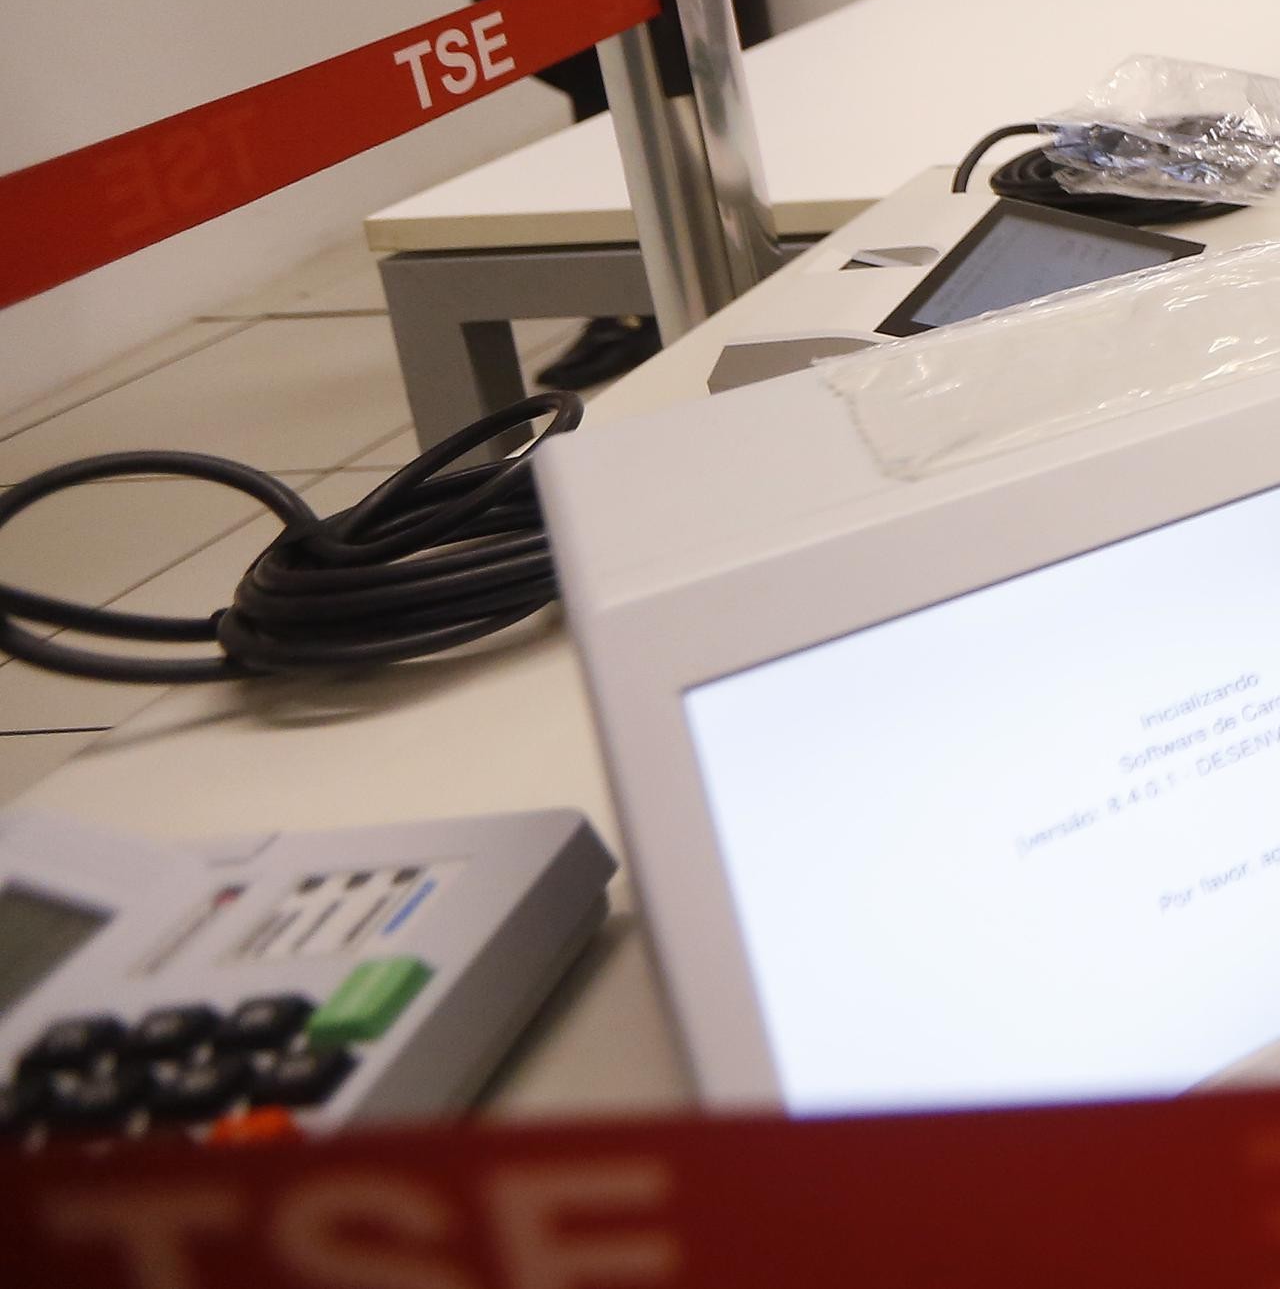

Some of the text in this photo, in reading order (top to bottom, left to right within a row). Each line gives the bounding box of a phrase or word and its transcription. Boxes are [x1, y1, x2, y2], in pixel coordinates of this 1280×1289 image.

[394, 12, 516, 110] TSE
[1139, 671, 1260, 731] Inicializando
[1118, 726, 1208, 775] Software
[1212, 712, 1238, 737] de
[1157, 887, 1195, 916] Por
